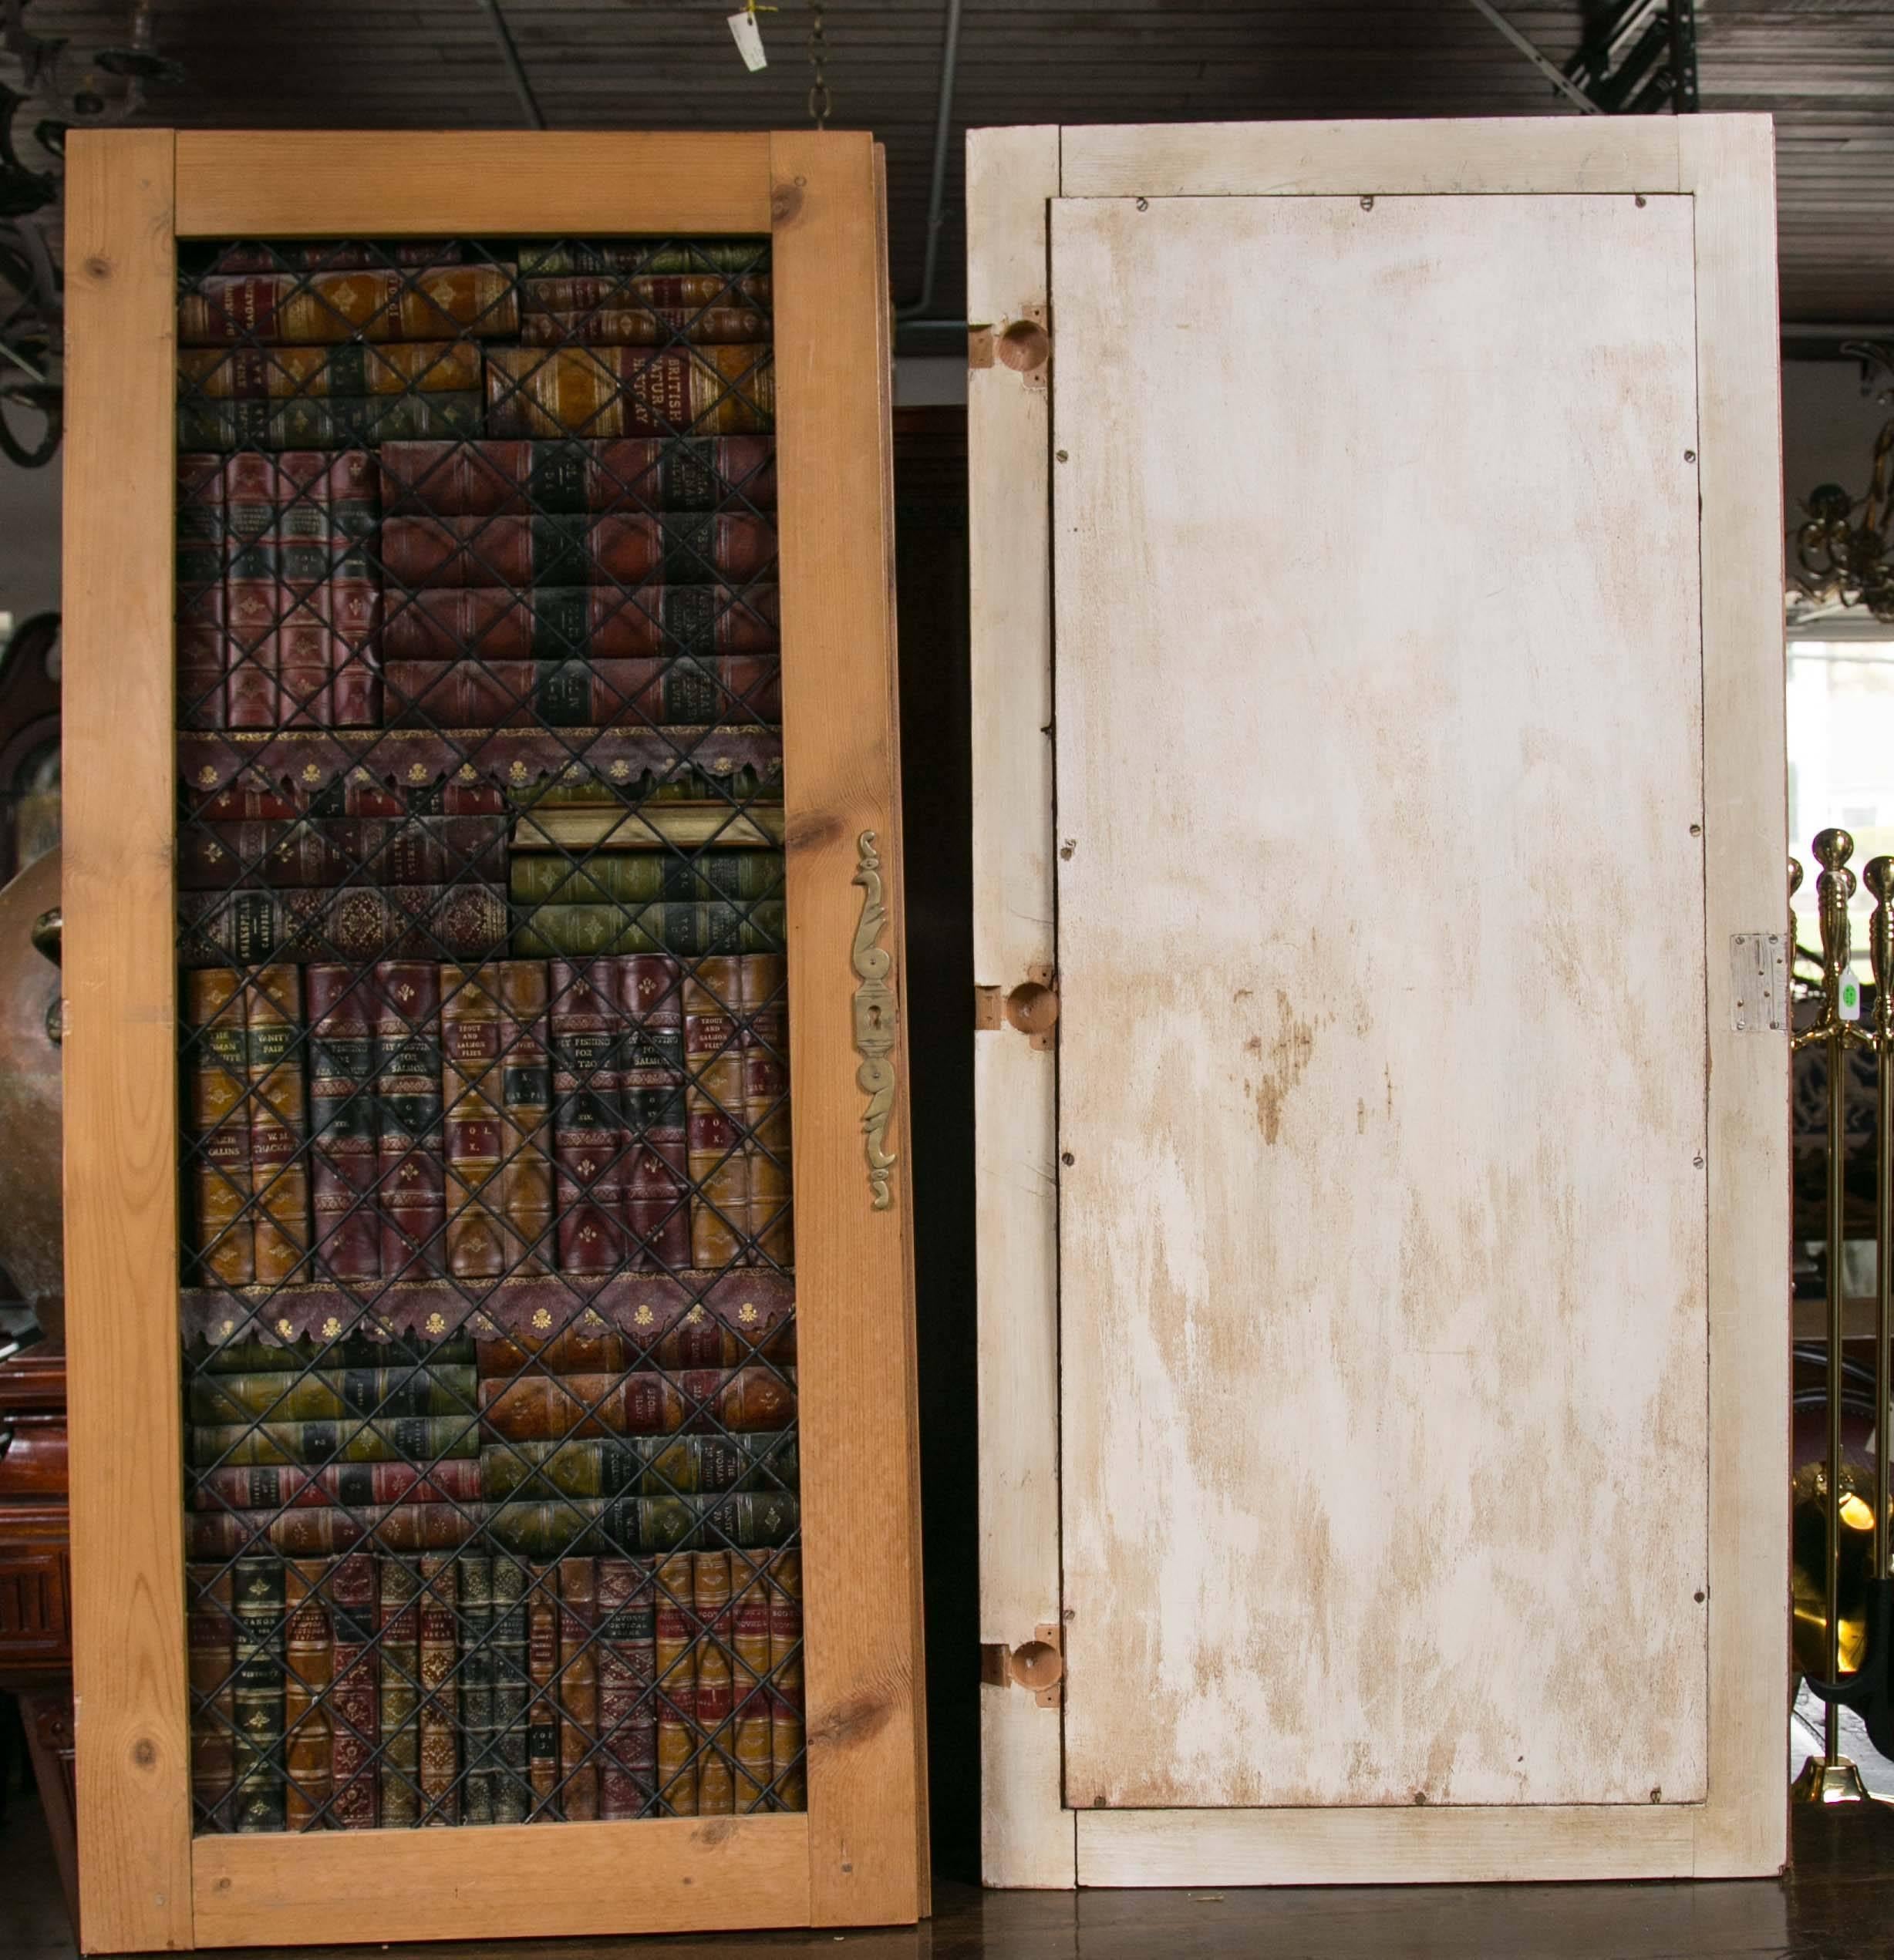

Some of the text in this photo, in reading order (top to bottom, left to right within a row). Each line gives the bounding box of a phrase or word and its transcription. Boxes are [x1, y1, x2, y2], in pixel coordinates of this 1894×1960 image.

[668, 358, 682, 422] BRITISH
[258, 1033, 290, 1042] VANITY
[263, 1045, 284, 1053] FAIR
[716, 1449, 725, 1484] WOMAN
